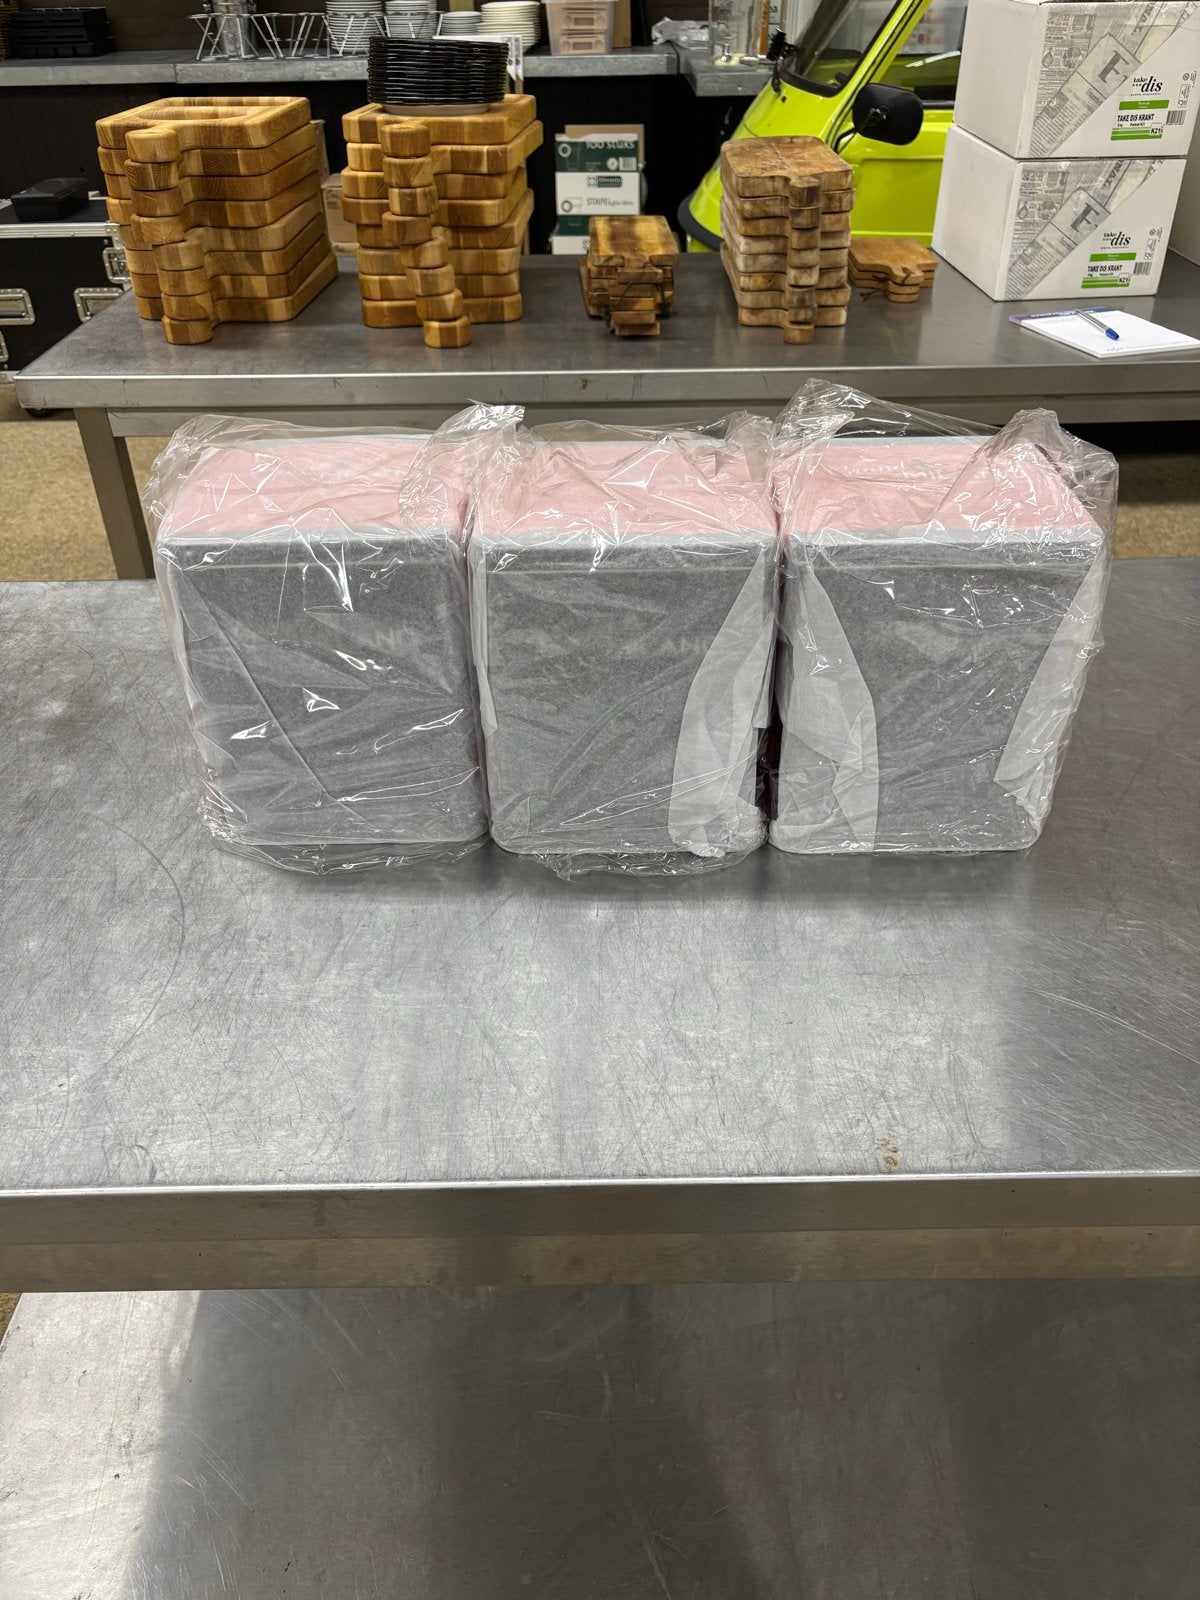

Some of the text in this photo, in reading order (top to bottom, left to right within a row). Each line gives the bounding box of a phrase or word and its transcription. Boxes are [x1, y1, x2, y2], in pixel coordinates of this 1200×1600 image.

[1141, 76, 1162, 92] dis
[1117, 113, 1155, 122] TAKE DIS KRANT
[1110, 231, 1130, 246] dis
